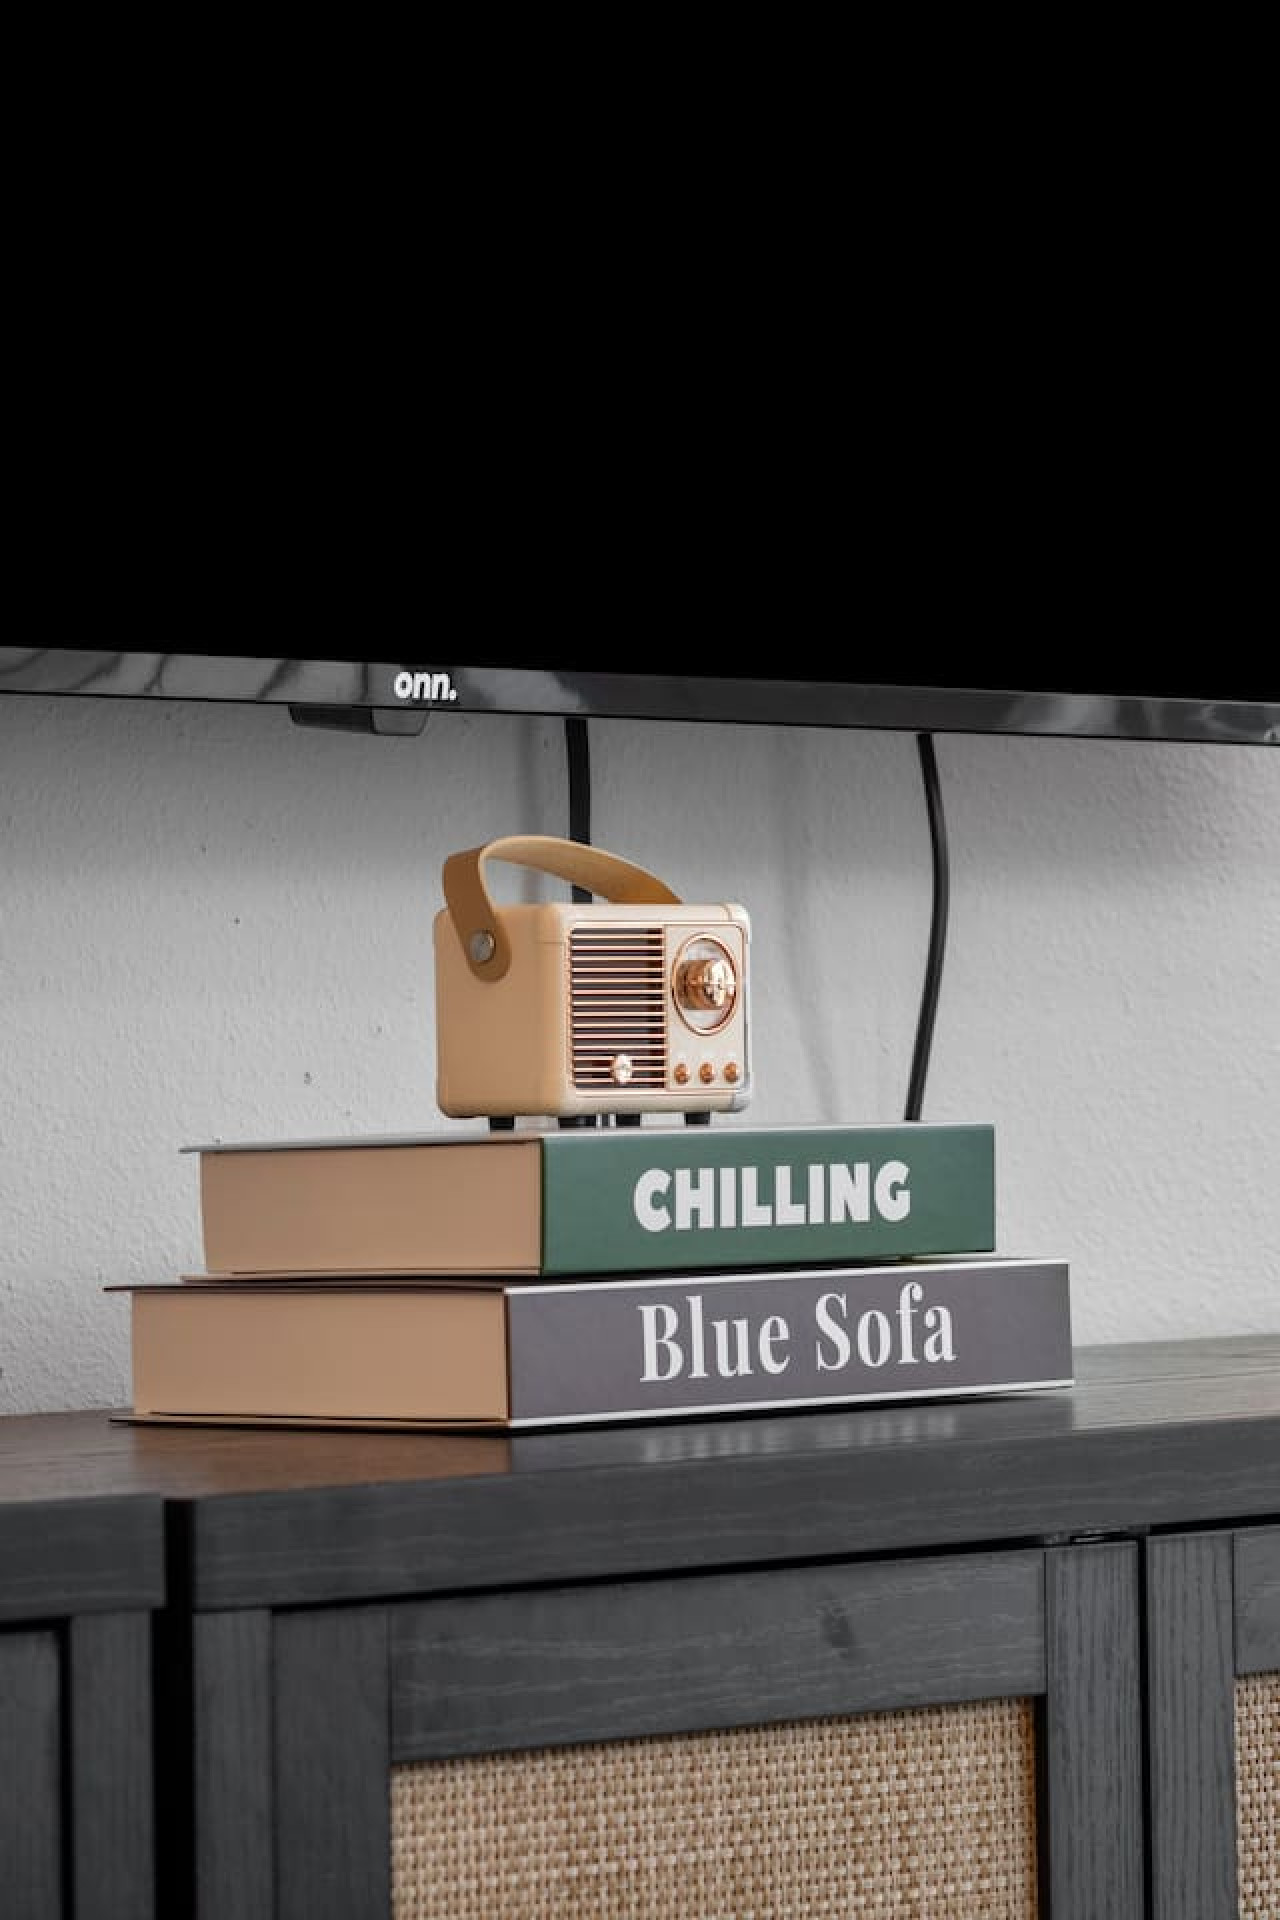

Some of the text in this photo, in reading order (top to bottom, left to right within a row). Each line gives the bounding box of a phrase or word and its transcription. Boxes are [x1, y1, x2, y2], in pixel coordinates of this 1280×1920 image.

[394, 671, 457, 701] onn.
[633, 1159, 912, 1233] CHILLING
[637, 1281, 956, 1383] Blue Sofa
